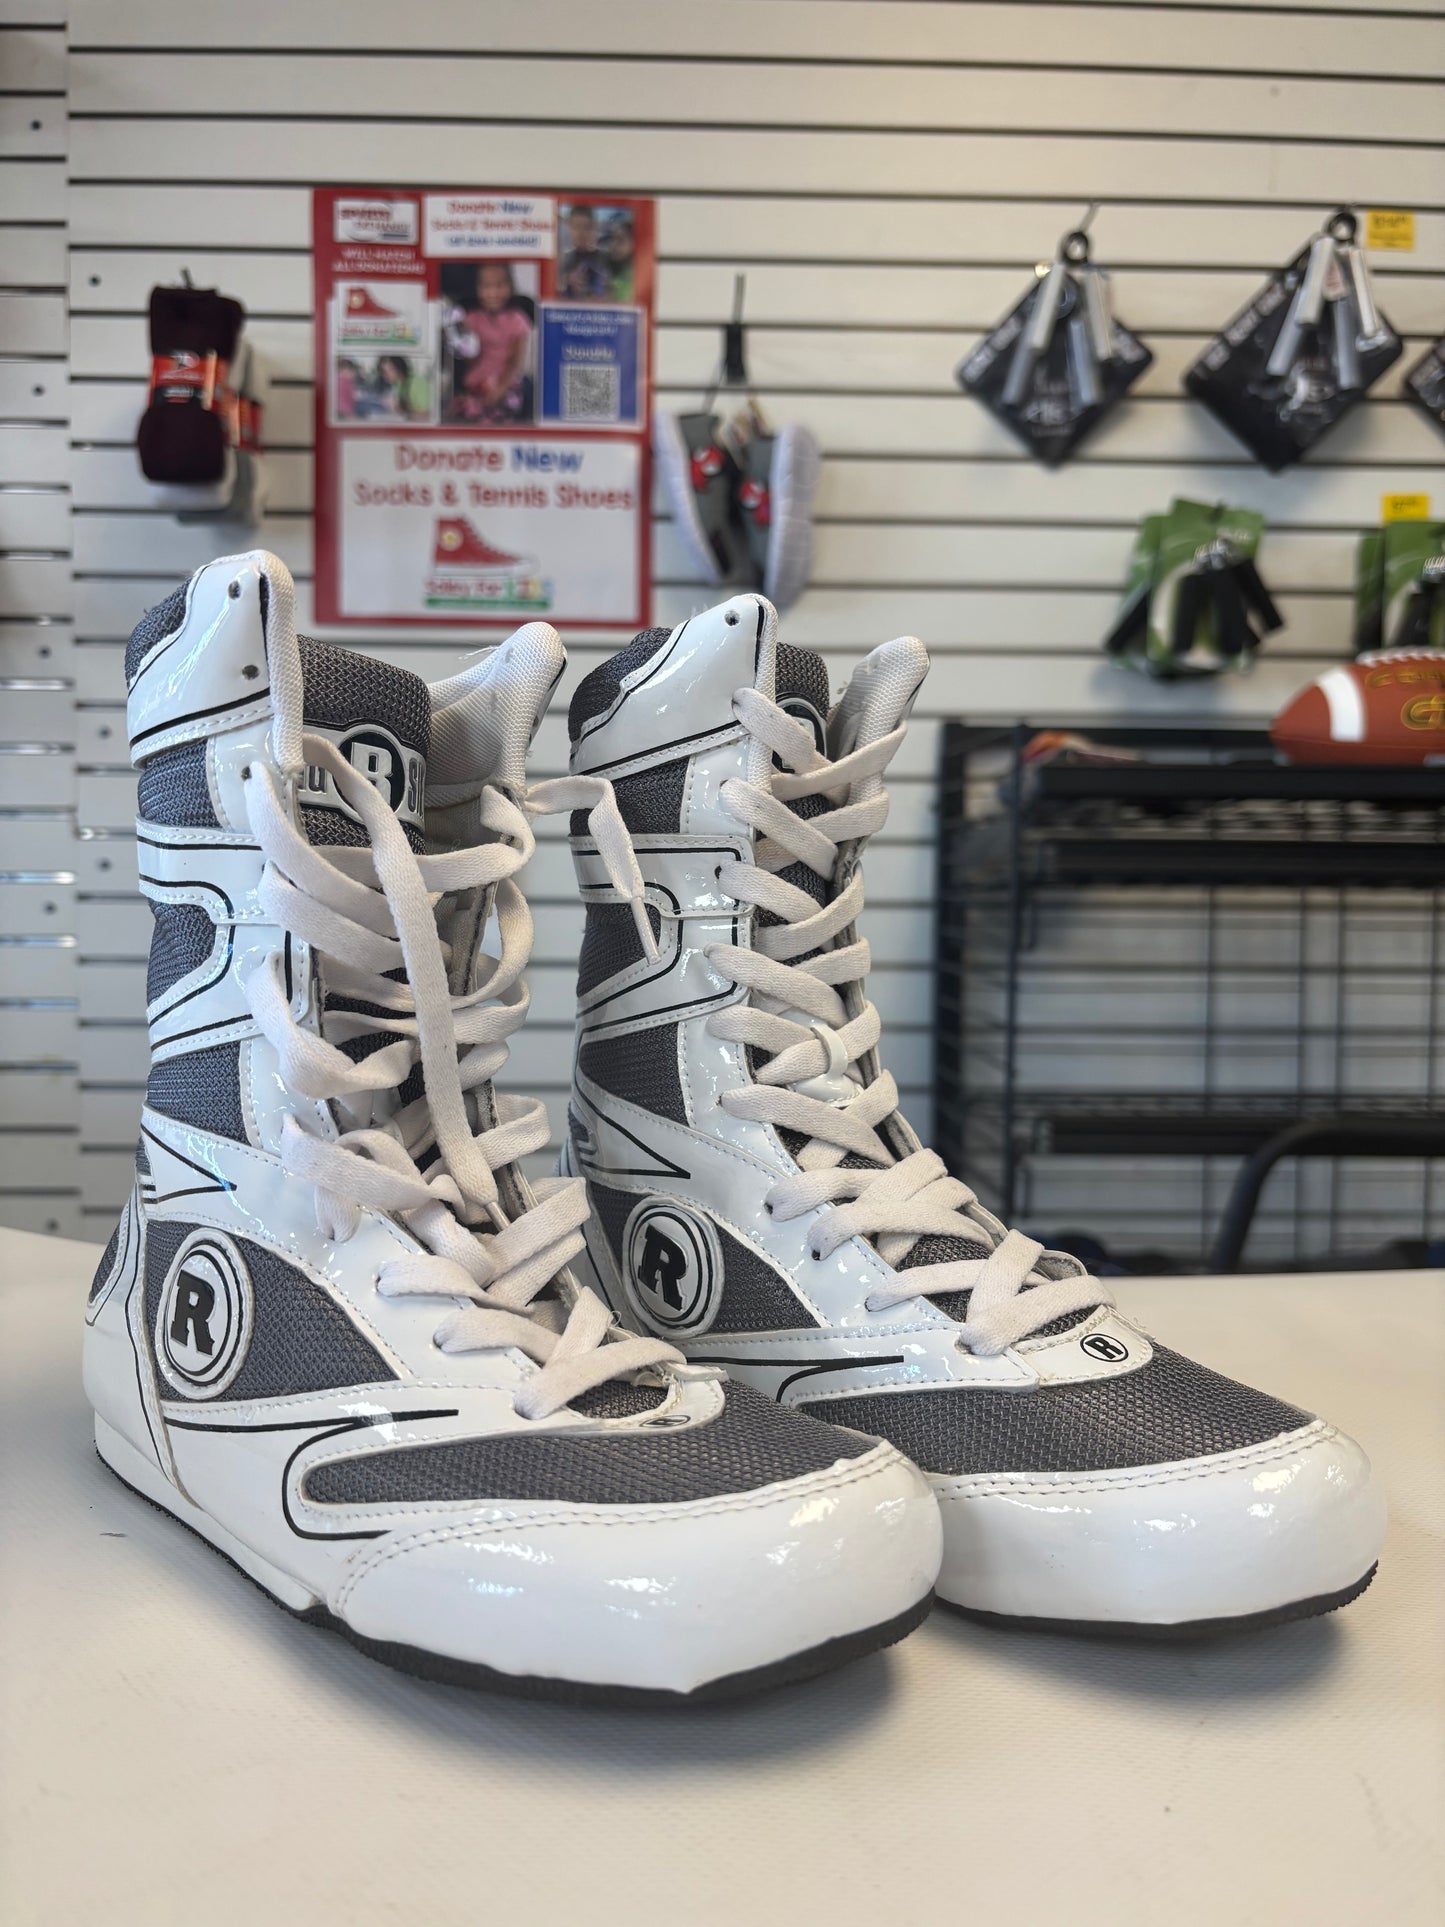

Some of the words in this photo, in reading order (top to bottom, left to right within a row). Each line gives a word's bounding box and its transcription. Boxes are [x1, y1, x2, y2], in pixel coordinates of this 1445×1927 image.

[394, 444, 504, 472] Donate
[511, 445, 584, 473] New
[354, 479, 437, 507] Socks
[440, 481, 461, 507] &
[468, 481, 550, 509] Tennis
[556, 482, 637, 510] Shoes
[637, 1223, 687, 1312] R
[170, 1269, 216, 1356] R
[1084, 1336, 1124, 1360] R
